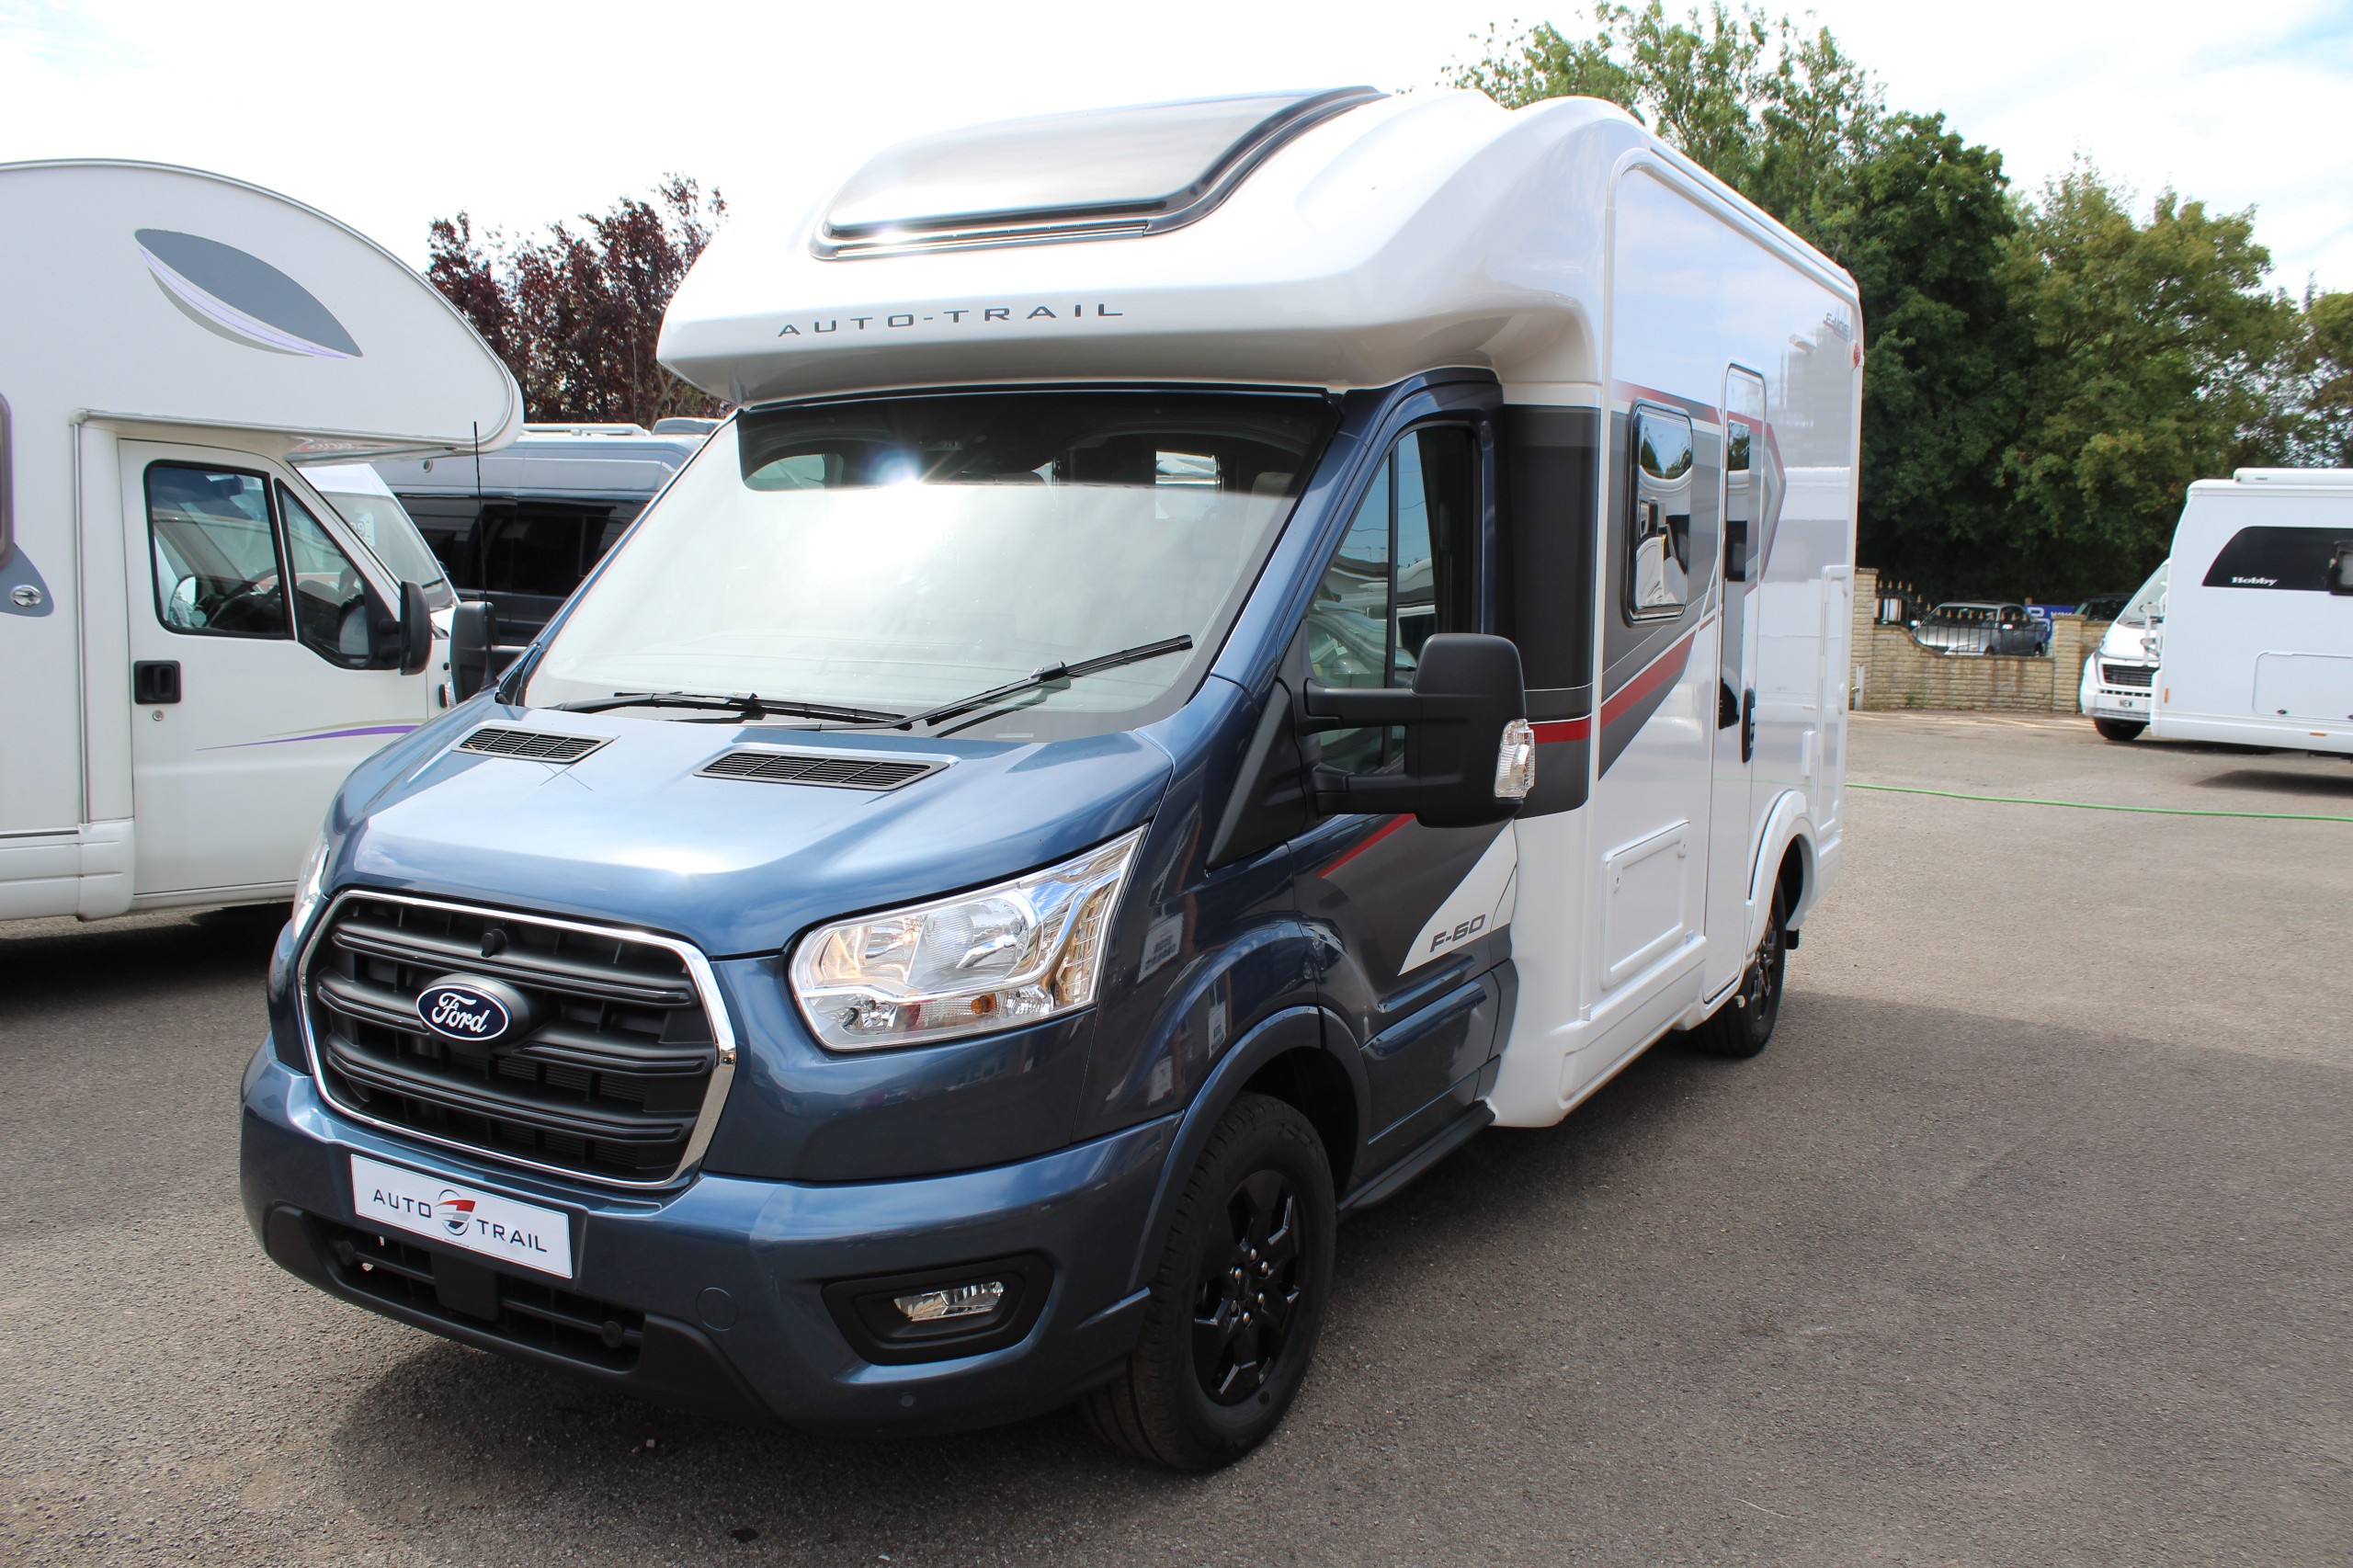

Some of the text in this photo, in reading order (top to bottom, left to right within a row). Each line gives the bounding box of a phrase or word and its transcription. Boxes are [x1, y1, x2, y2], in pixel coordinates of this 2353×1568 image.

[778, 303, 1123, 338] AUTO-TRAIL
[2231, 576, 2279, 586] Hobby
[1429, 914, 1485, 953] F-60
[431, 992, 491, 1033] Ford
[373, 1188, 548, 1253] AUTO TRAIL
